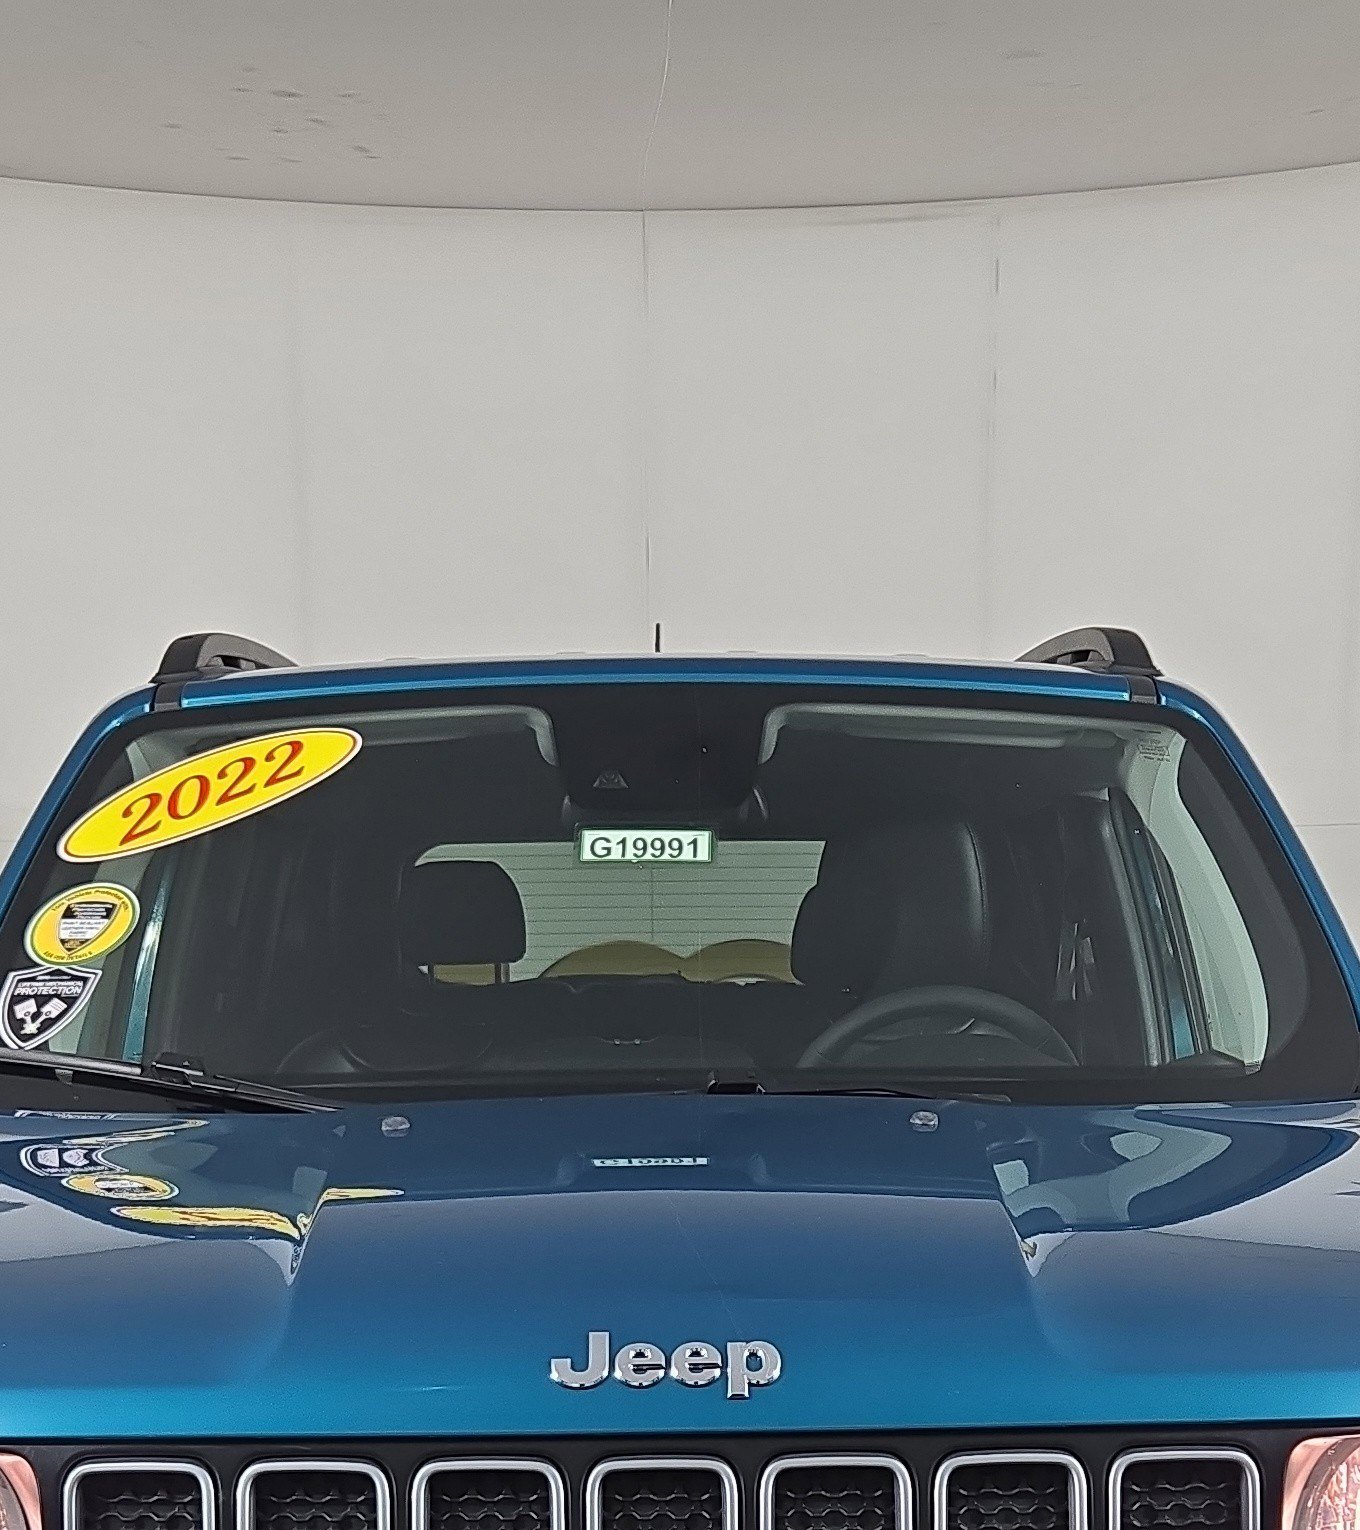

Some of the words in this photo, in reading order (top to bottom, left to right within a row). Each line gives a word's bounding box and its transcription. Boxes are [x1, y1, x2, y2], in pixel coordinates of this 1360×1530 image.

[119, 741, 304, 846] 2022
[590, 837, 698, 858] G19991
[14, 986, 83, 996] PROTECTION
[550, 1331, 782, 1399] Jeep
